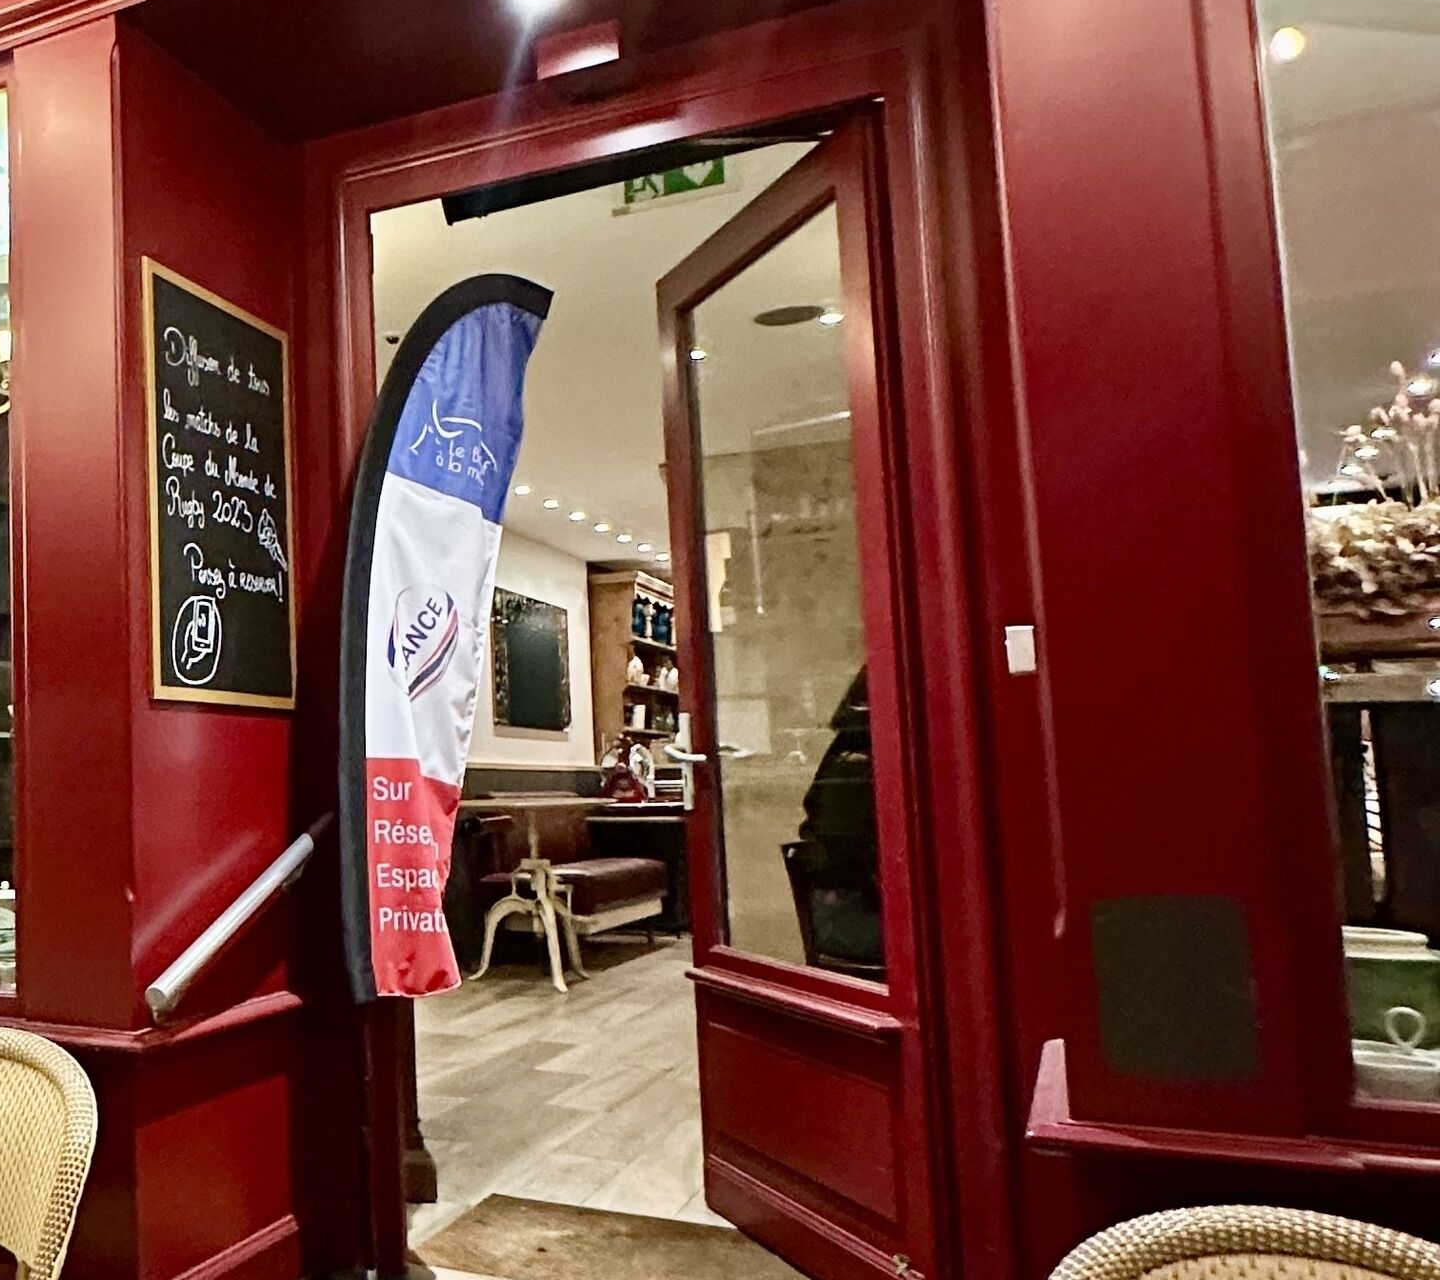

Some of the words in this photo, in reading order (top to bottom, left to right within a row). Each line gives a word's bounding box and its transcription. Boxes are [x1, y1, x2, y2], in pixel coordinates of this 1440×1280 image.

[227, 357, 240, 384] de
[164, 388, 179, 422] les
[226, 422, 239, 445] de
[245, 423, 260, 453] la
[162, 433, 195, 477] Coupe
[205, 449, 220, 478] du
[225, 454, 260, 495] Monde
[264, 473, 277, 499] de
[166, 476, 205, 529] Rugby
[212, 490, 253, 533] 2023
[402, 597, 443, 671] ANCE
[373, 776, 412, 801] Sur
[374, 819, 439, 852] Rése
